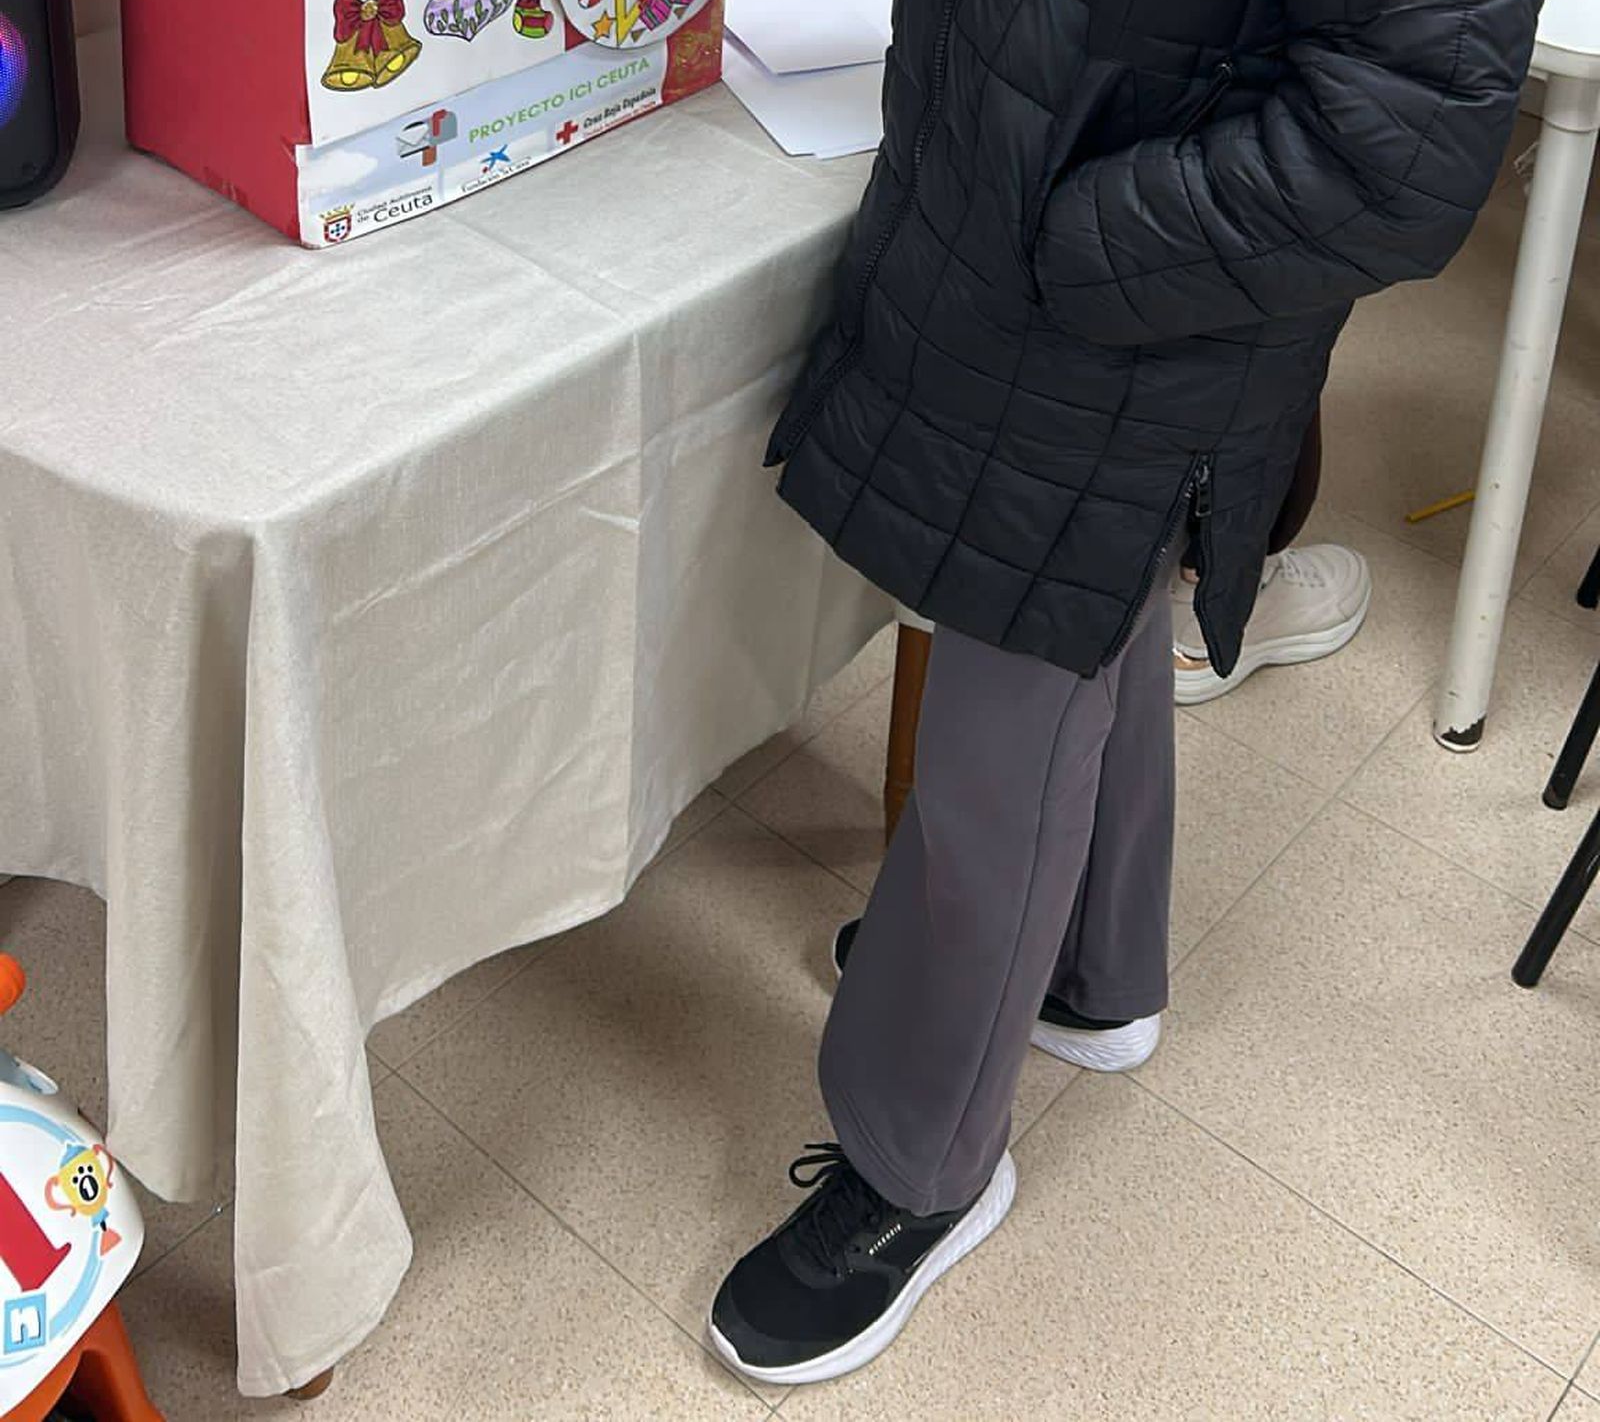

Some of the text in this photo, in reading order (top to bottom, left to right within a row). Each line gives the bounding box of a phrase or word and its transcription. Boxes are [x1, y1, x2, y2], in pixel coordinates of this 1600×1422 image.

[468, 93, 565, 144] PROYECTO
[569, 81, 592, 102] ICI
[596, 57, 650, 89] CEUTA
[372, 192, 433, 224] Ceuta
